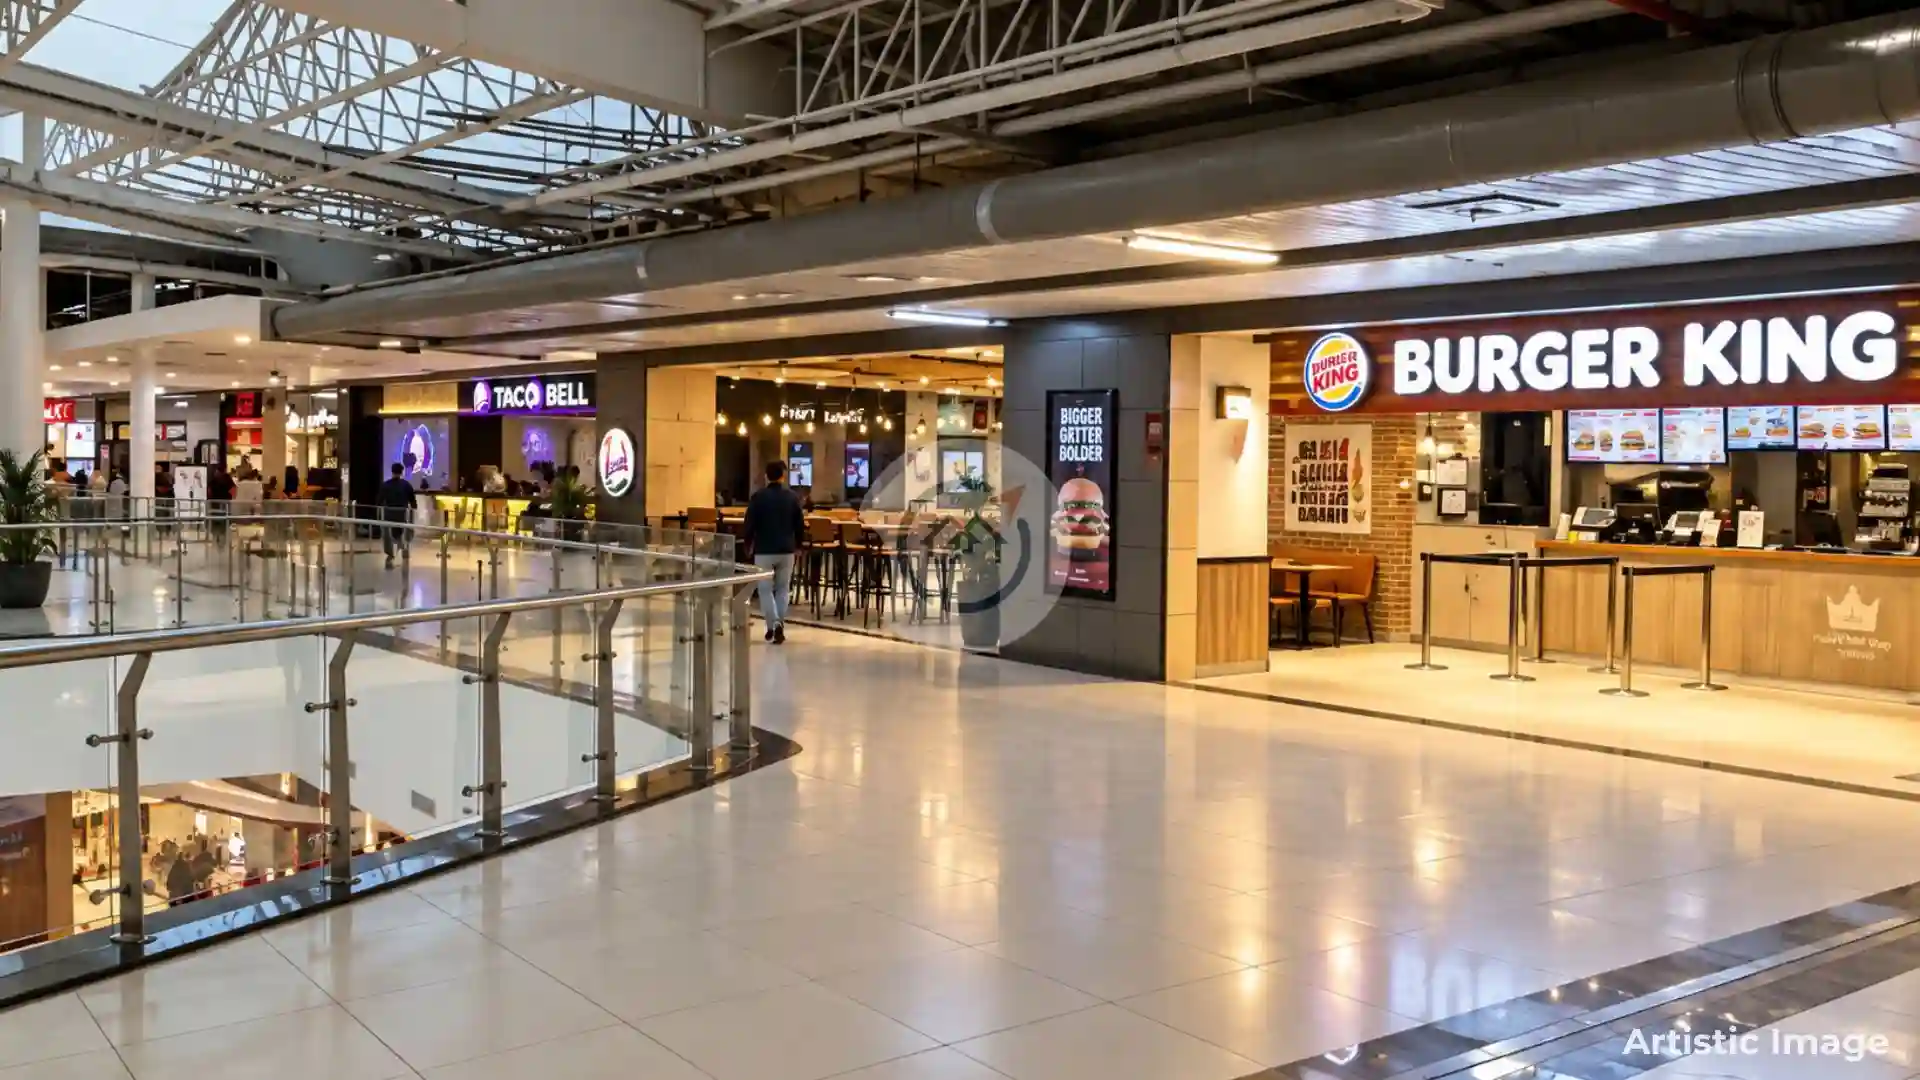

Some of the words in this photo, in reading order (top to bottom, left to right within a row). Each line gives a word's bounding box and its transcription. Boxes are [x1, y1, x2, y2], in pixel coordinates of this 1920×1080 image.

[1394, 326, 1660, 395] BURGER
[1684, 311, 1897, 386] KING
[1313, 363, 1359, 394] KING
[494, 382, 541, 409] TACO
[546, 381, 589, 406] BELL
[1060, 407, 1103, 425] BIGGER
[1059, 444, 1103, 462] BOLDER
